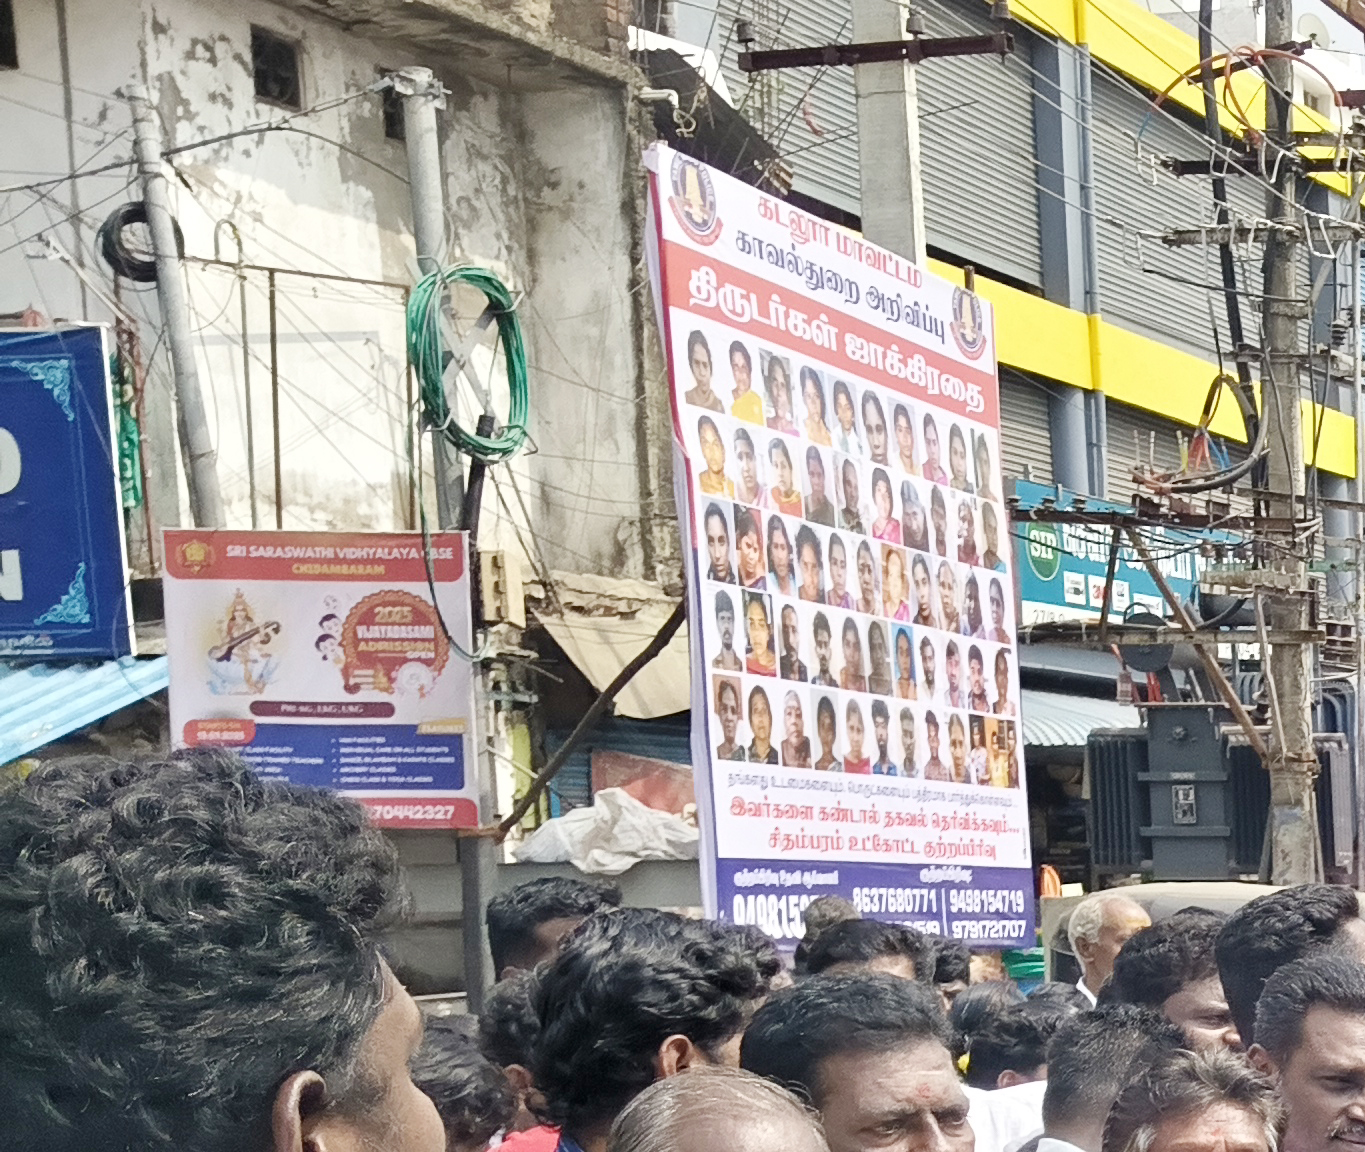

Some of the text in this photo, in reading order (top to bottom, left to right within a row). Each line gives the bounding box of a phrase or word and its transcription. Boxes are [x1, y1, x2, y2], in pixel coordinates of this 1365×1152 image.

[735, 229, 860, 306] காவல்துறை
[866, 285, 946, 345] அறிவிப்பு
[688, 265, 986, 414] திருடர்கள் ஜாக்கிரதை
[226, 545, 247, 557] SRI
[249, 546, 335, 559] SARASWATHI
[336, 547, 419, 560] VIDHYALAYA
[1028, 530, 1058, 560] SIP
[729, 795, 814, 821] இவர்களை
[818, 801, 880, 826] கண்டால்
[884, 807, 928, 829] தகவல்
[768, 828, 845, 851] சிதம்பரம்
[853, 887, 1025, 913] 8637680771 9498154719
